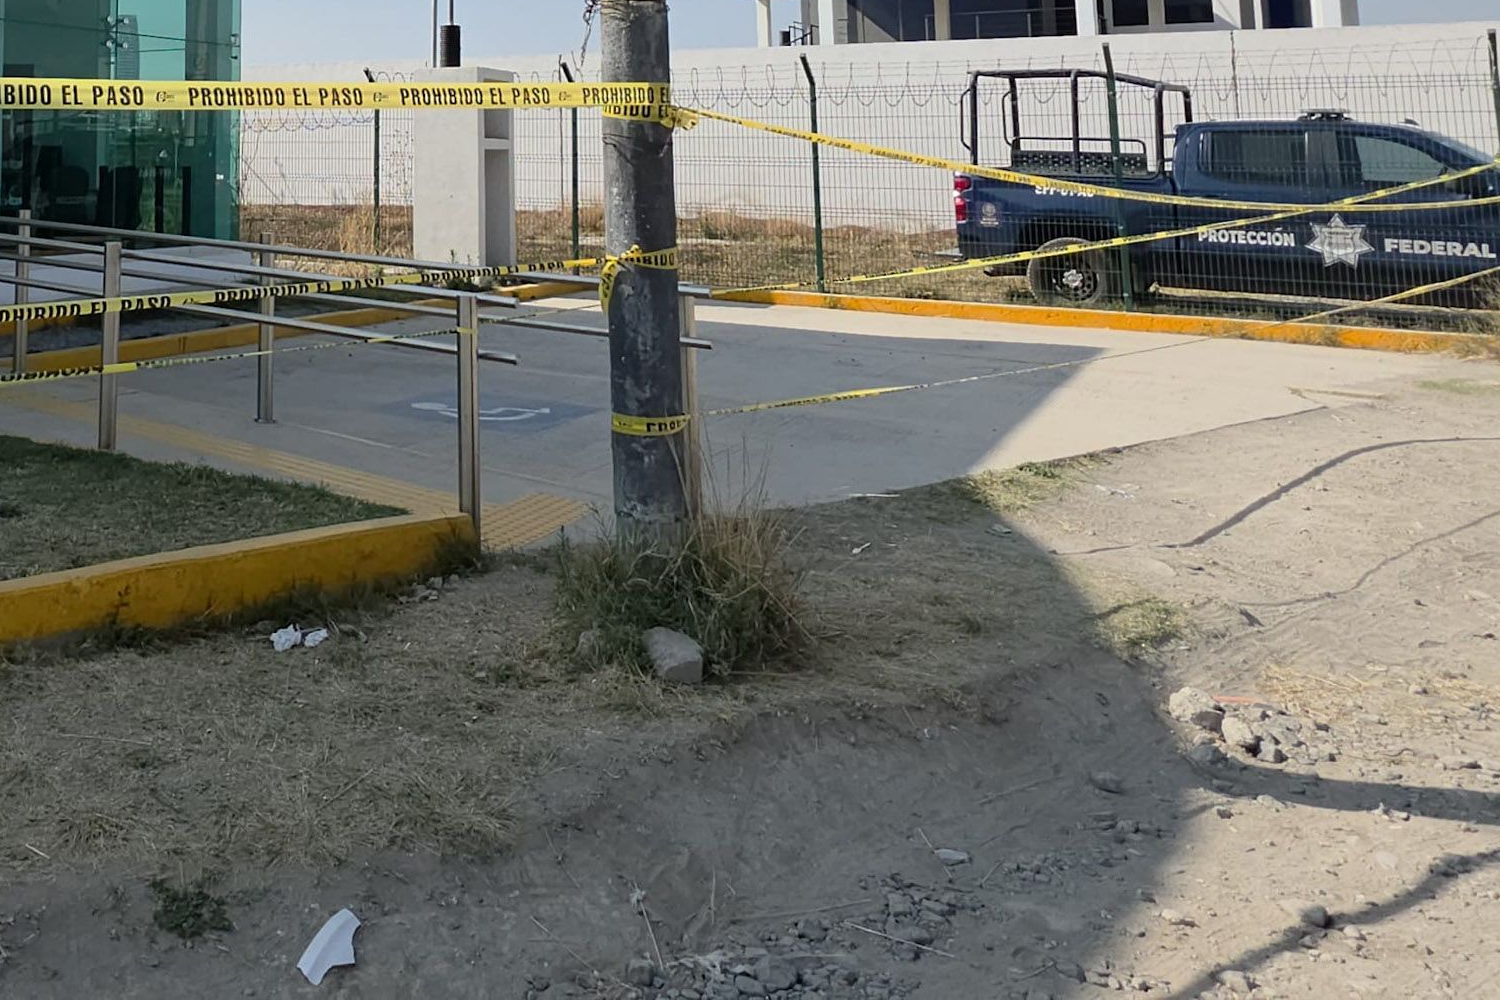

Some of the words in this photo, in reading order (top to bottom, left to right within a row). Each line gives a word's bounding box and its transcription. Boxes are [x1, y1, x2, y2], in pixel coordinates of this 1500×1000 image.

[62, 85, 83, 106] EL
[93, 85, 144, 107] PASO
[188, 86, 285, 107] PROHIBIDO
[293, 87, 312, 107] EL
[319, 87, 363, 107] PASO
[400, 88, 483, 106] PROHIBIDO
[490, 88, 505, 105] EL
[512, 88, 550, 105] PASO
[582, 87, 654, 104] PROHIBIDO
[660, 86, 670, 103] EL
[1198, 227, 1296, 247] PROTECCIÓN
[1384, 238, 1497, 259] FEDERAL
[120, 296, 172, 312] PASO
